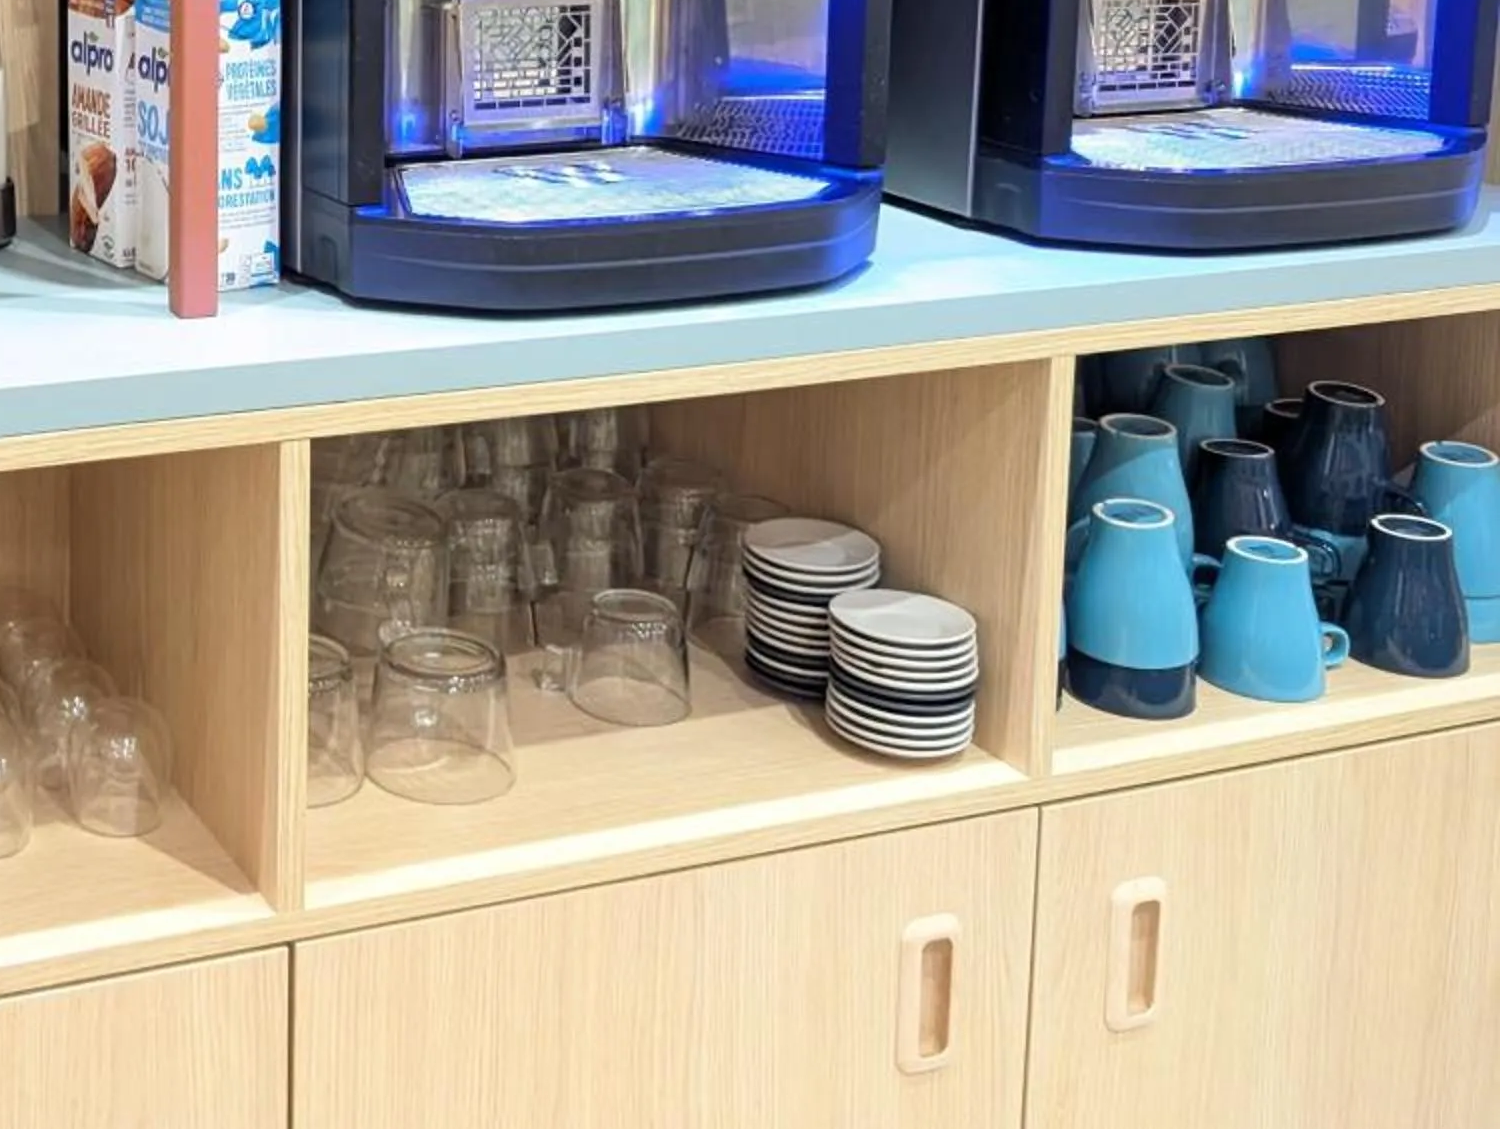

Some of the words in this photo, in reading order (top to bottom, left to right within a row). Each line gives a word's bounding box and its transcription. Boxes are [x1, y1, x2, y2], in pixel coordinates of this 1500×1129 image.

[71, 31, 114, 76] alpro
[138, 46, 171, 94] alp
[71, 83, 112, 120] AMANDE
[138, 100, 170, 145] SOJ
[218, 168, 243, 190] NS
